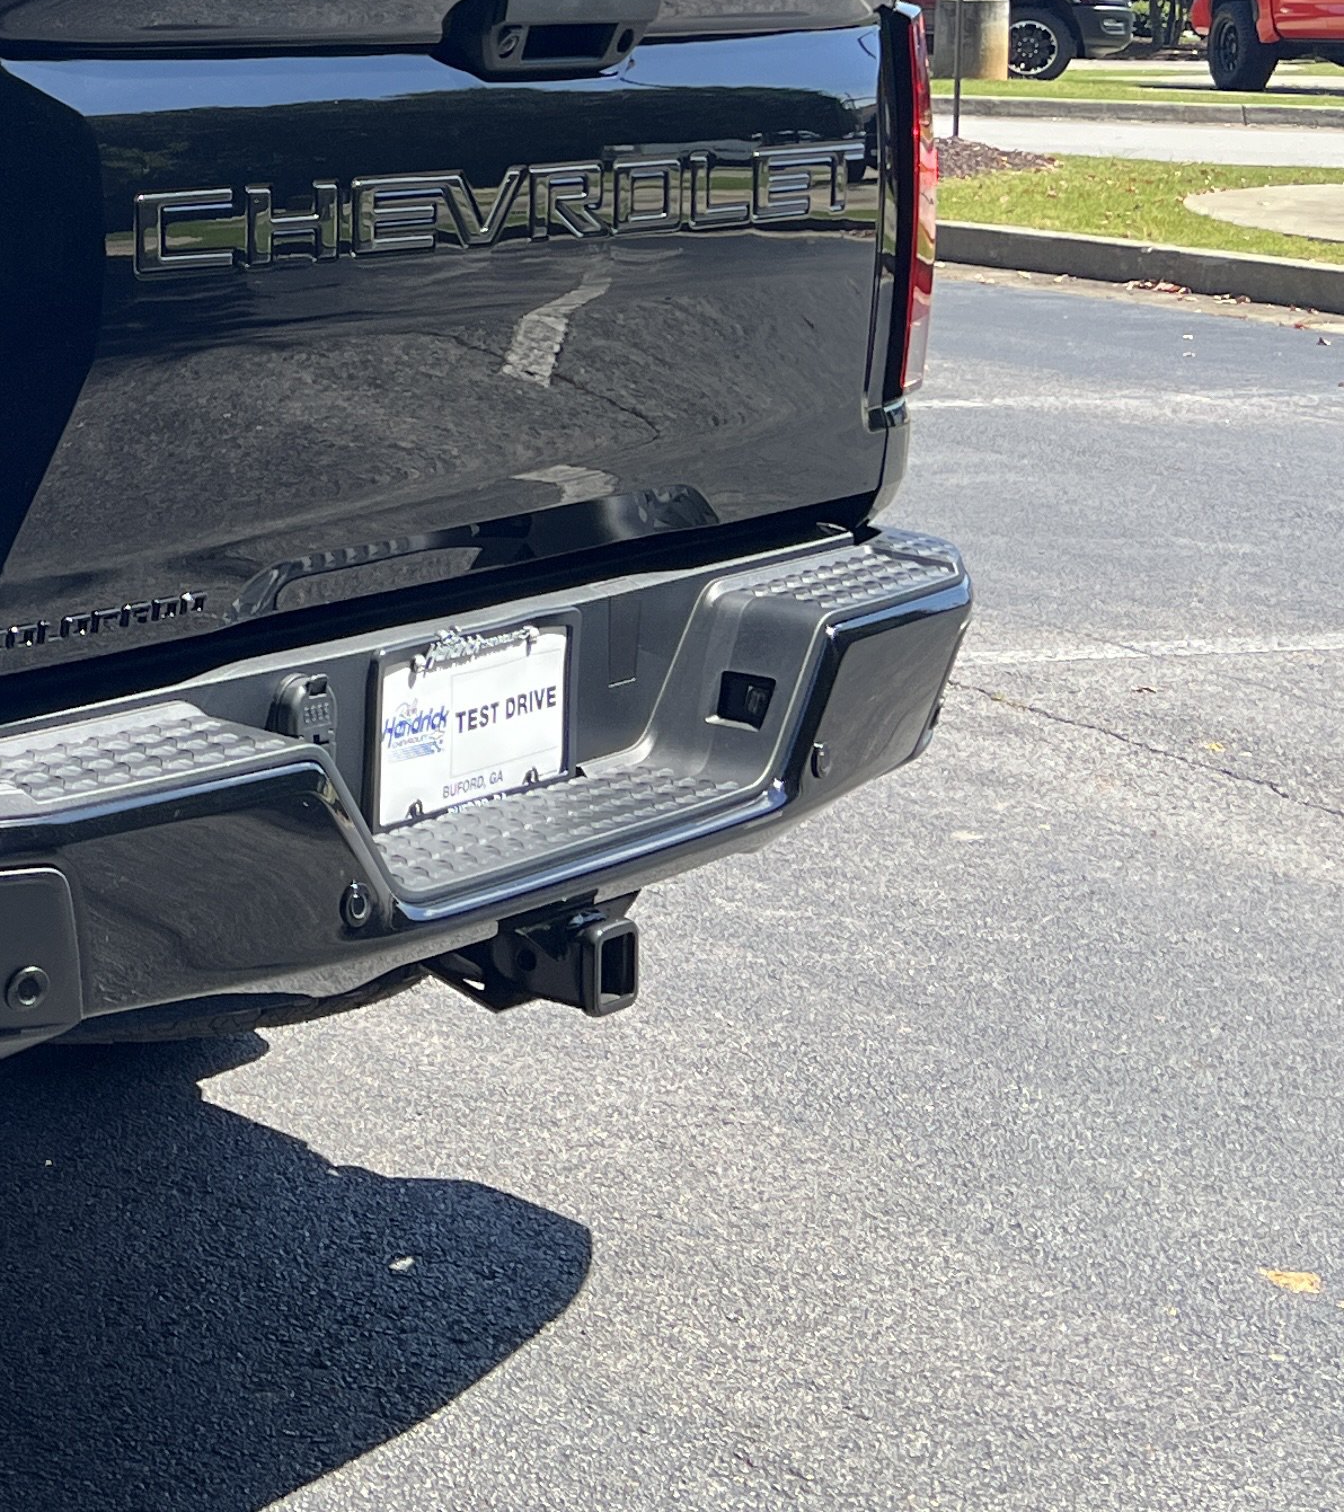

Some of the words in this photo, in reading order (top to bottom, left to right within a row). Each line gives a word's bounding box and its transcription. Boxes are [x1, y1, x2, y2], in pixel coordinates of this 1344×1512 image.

[132, 141, 865, 281] CHEVROLET
[455, 701, 500, 734] TEST
[505, 686, 557, 720] DRIVE
[442, 776, 486, 799] BUFORD,
[489, 769, 504, 785] GA
